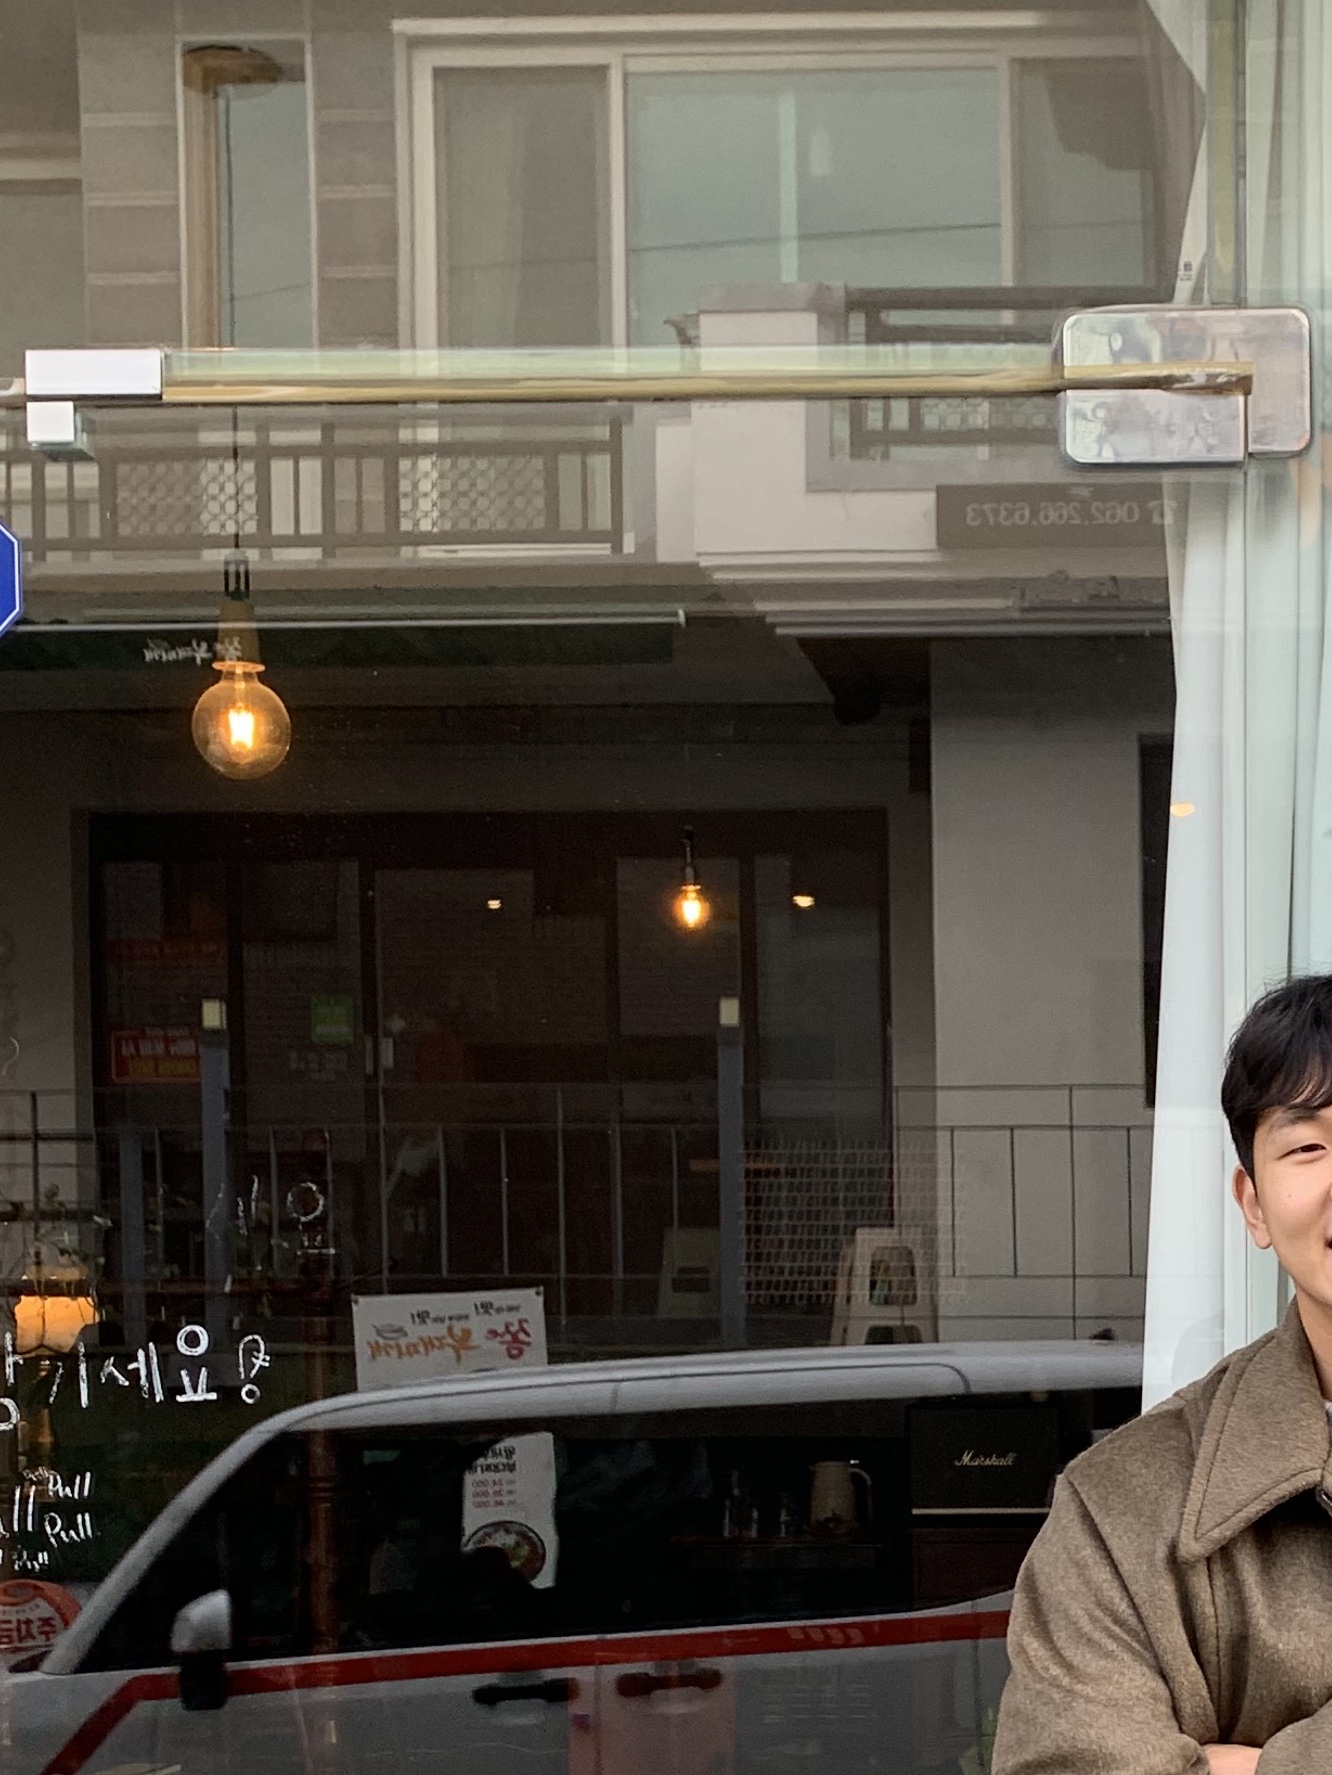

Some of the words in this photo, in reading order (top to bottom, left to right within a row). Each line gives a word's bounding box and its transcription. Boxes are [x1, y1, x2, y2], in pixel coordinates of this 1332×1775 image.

[954, 1449, 1017, 1467] Marshall
[48, 1471, 92, 1499] Pull
[44, 1511, 93, 1548] Pull
